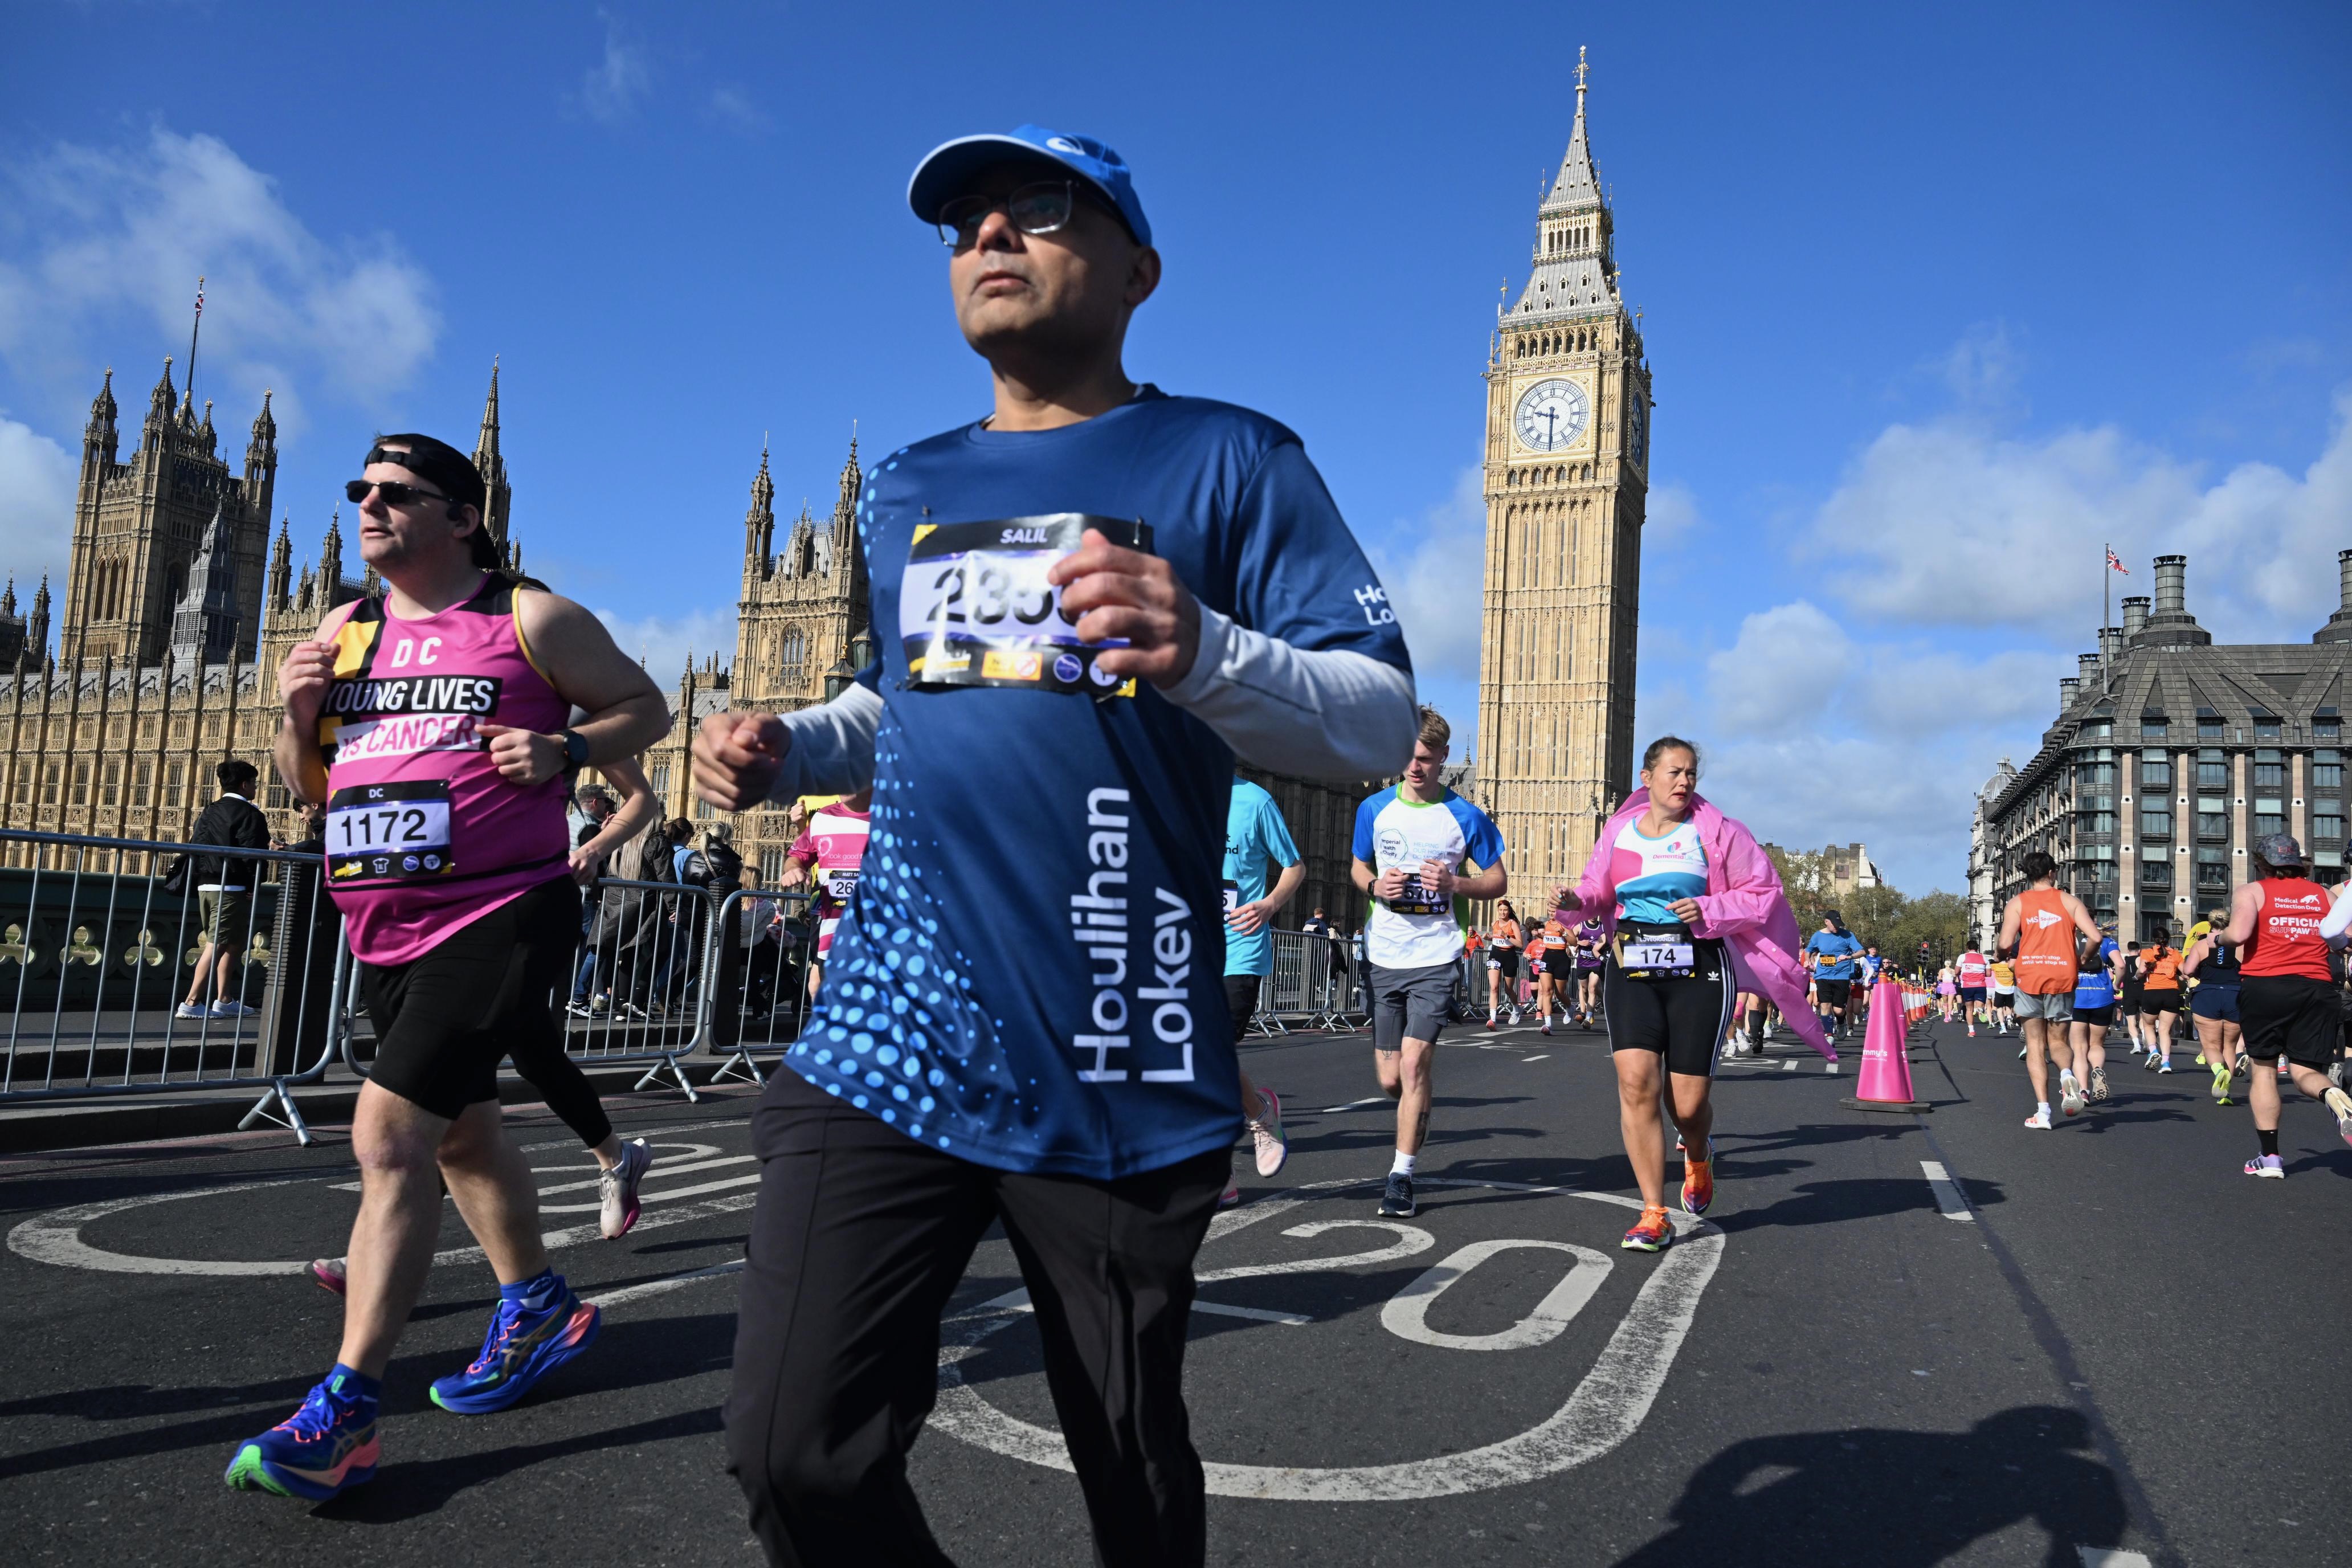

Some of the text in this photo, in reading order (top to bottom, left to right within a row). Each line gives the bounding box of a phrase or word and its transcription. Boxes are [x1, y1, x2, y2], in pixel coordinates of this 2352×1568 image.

[1000, 528, 1048, 544] SALIL
[926, 566, 1077, 626] 235
[325, 678, 494, 712] YOUNG LIVES
[366, 715, 477, 752] CANCER
[369, 789, 383, 798] DC
[341, 809, 427, 847] 1172
[836, 881, 854, 895] 26
[2026, 916, 2039, 925] MS
[2269, 916, 2321, 928] OFFICIA
[1071, 787, 1130, 1081] Houlihan
[2269, 926, 2320, 936] SUPPAWTE
[1641, 948, 1676, 964] 174
[979, 1219, 1614, 1351] 20
